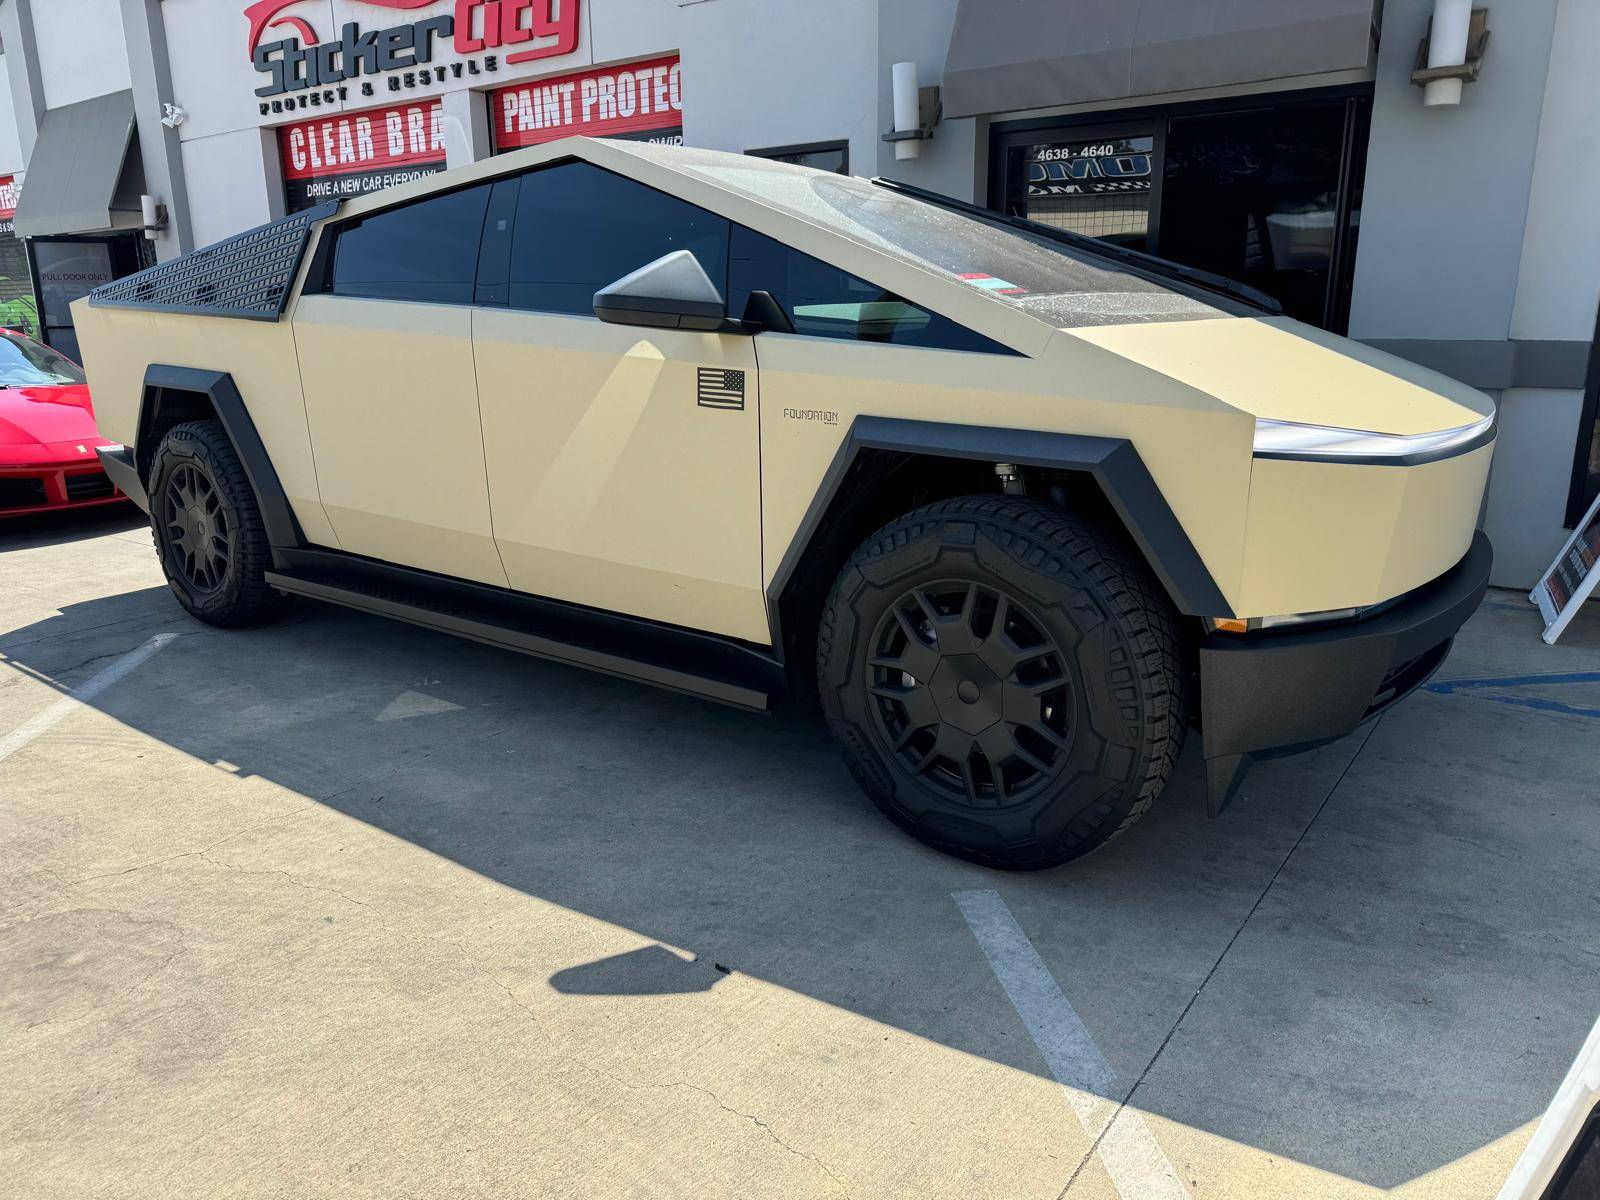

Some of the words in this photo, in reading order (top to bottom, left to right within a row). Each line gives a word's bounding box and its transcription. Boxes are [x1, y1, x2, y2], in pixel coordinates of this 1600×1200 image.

[259, 87, 348, 115] PROTECT
[361, 82, 374, 96] &
[388, 55, 498, 91] RESTYLE
[503, 80, 575, 132] PAINT
[290, 116, 374, 171] CLEAR
[1037, 148, 1069, 161] 4638
[1080, 145, 1113, 158] 4640
[306, 181, 332, 198] DRIVE
[333, 183, 340, 194] A
[341, 177, 361, 193] NEW
[363, 177, 382, 191] CAR
[42, 273, 61, 281] PULL
[63, 273, 86, 281] DOOR
[88, 273, 107, 281] ONLY
[783, 408, 838, 422] FOUNDATION
